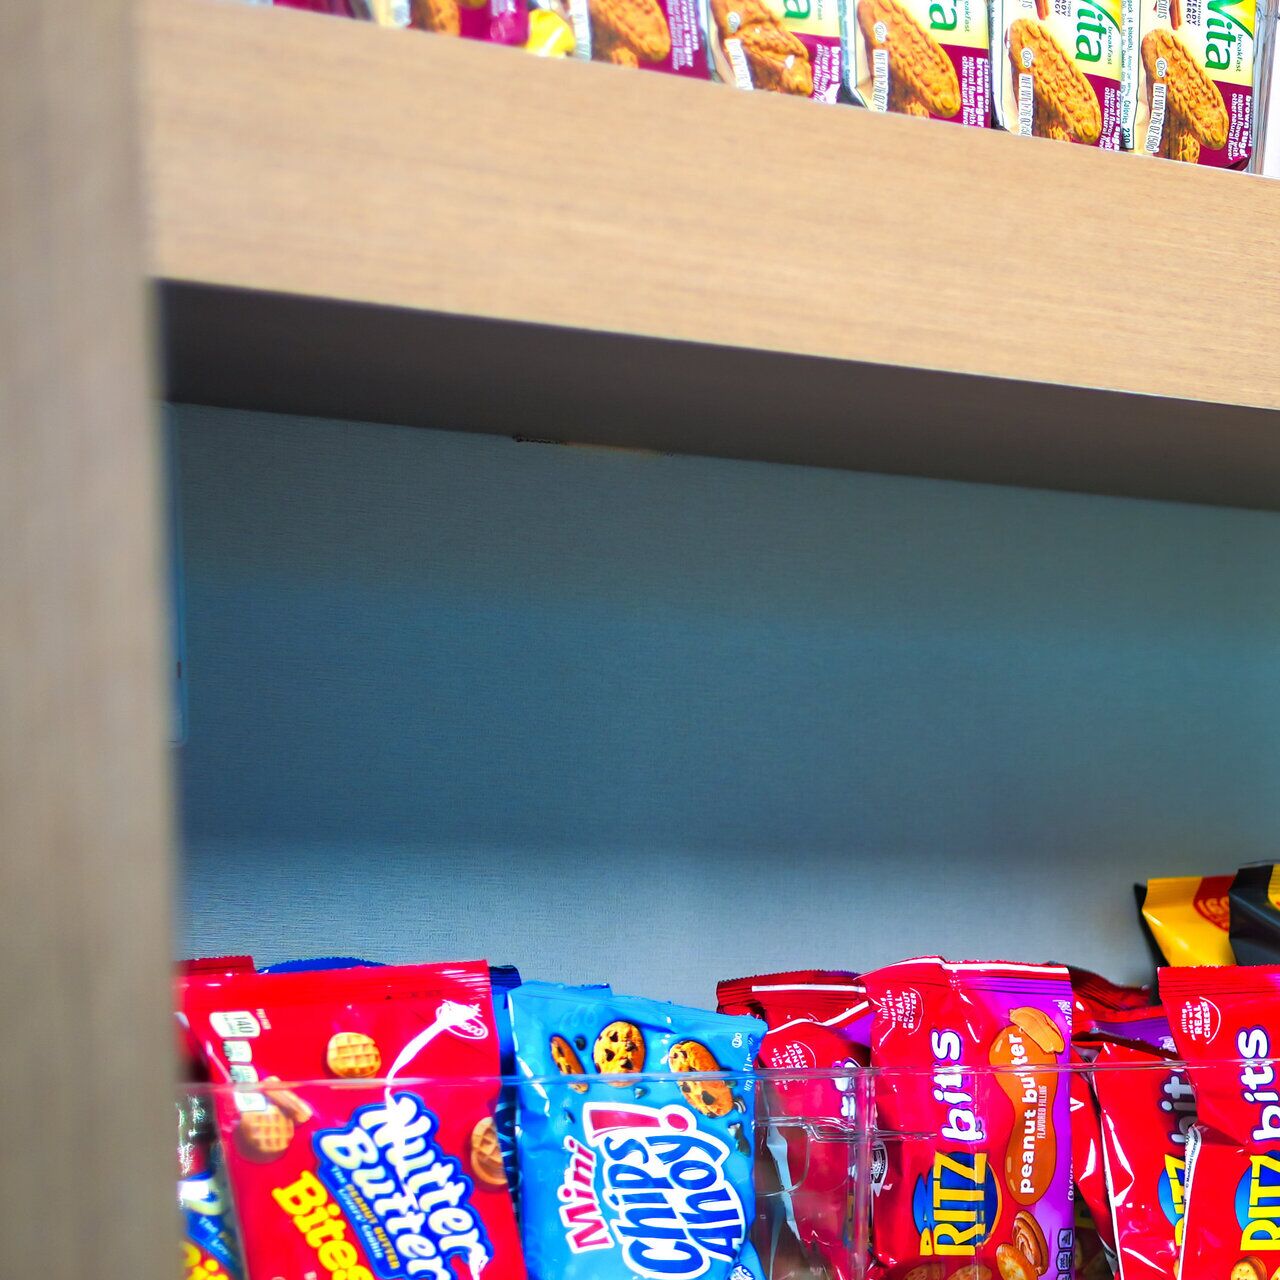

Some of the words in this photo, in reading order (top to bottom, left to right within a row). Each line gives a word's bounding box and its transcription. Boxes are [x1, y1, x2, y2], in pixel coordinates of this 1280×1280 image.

[1193, 1004, 1203, 1035] REAL
[1201, 1001, 1211, 1038] CHEESE
[930, 1030, 985, 1141] bits
[1008, 1031, 1037, 1105] butter
[563, 1137, 611, 1250] Mini
[1019, 1107, 1037, 1194] peanut
[605, 1134, 704, 1274] Chips
[933, 1151, 988, 1257] RITZ
